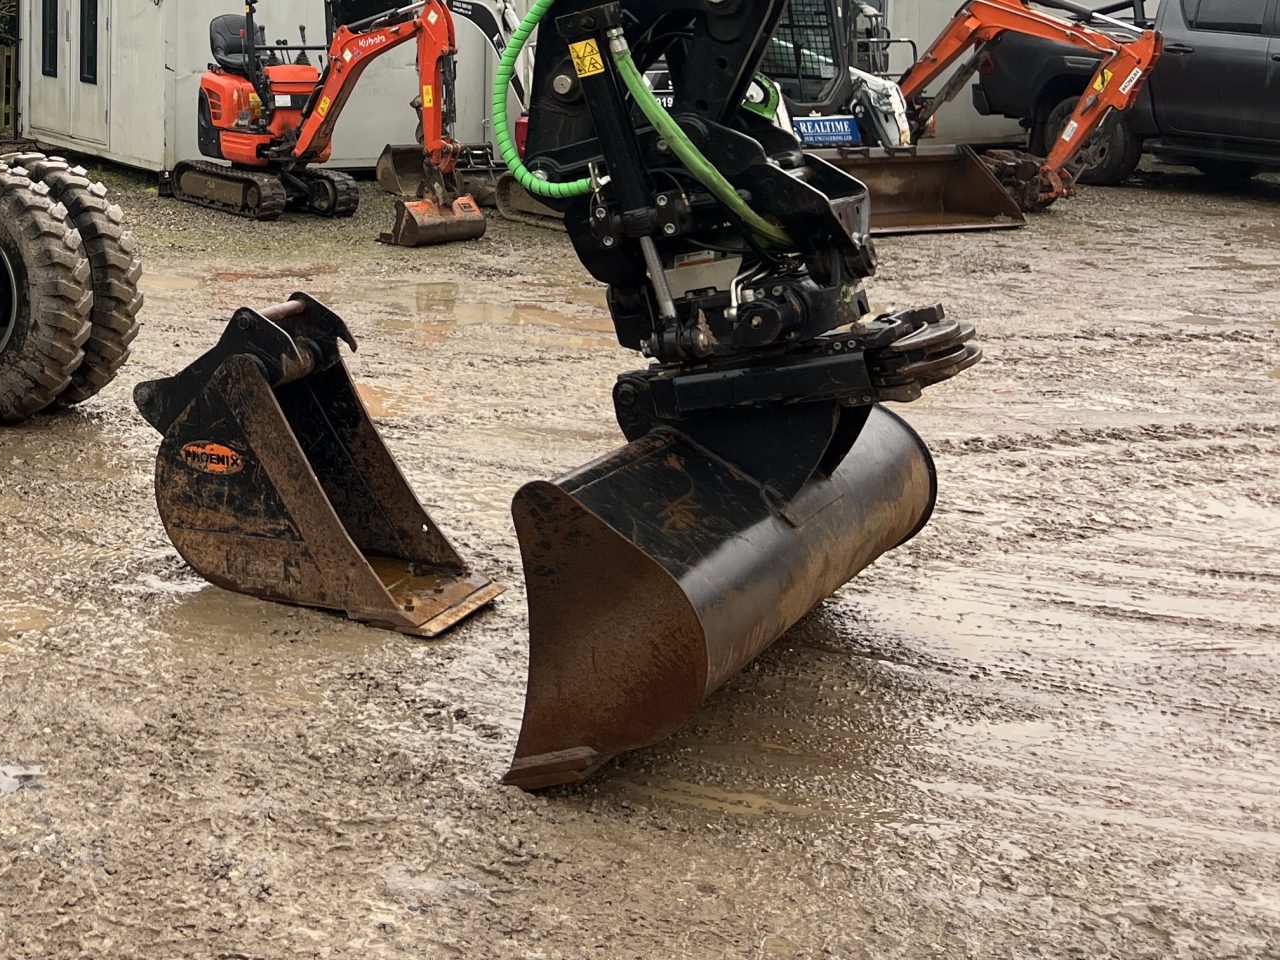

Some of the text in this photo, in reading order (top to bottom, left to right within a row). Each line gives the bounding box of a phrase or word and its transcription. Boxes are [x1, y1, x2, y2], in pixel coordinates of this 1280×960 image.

[358, 35, 386, 47] Kubota
[1121, 70, 1139, 91] HITACHI
[800, 121, 851, 133] REALTIME
[185, 450, 241, 468] PHOENIX
